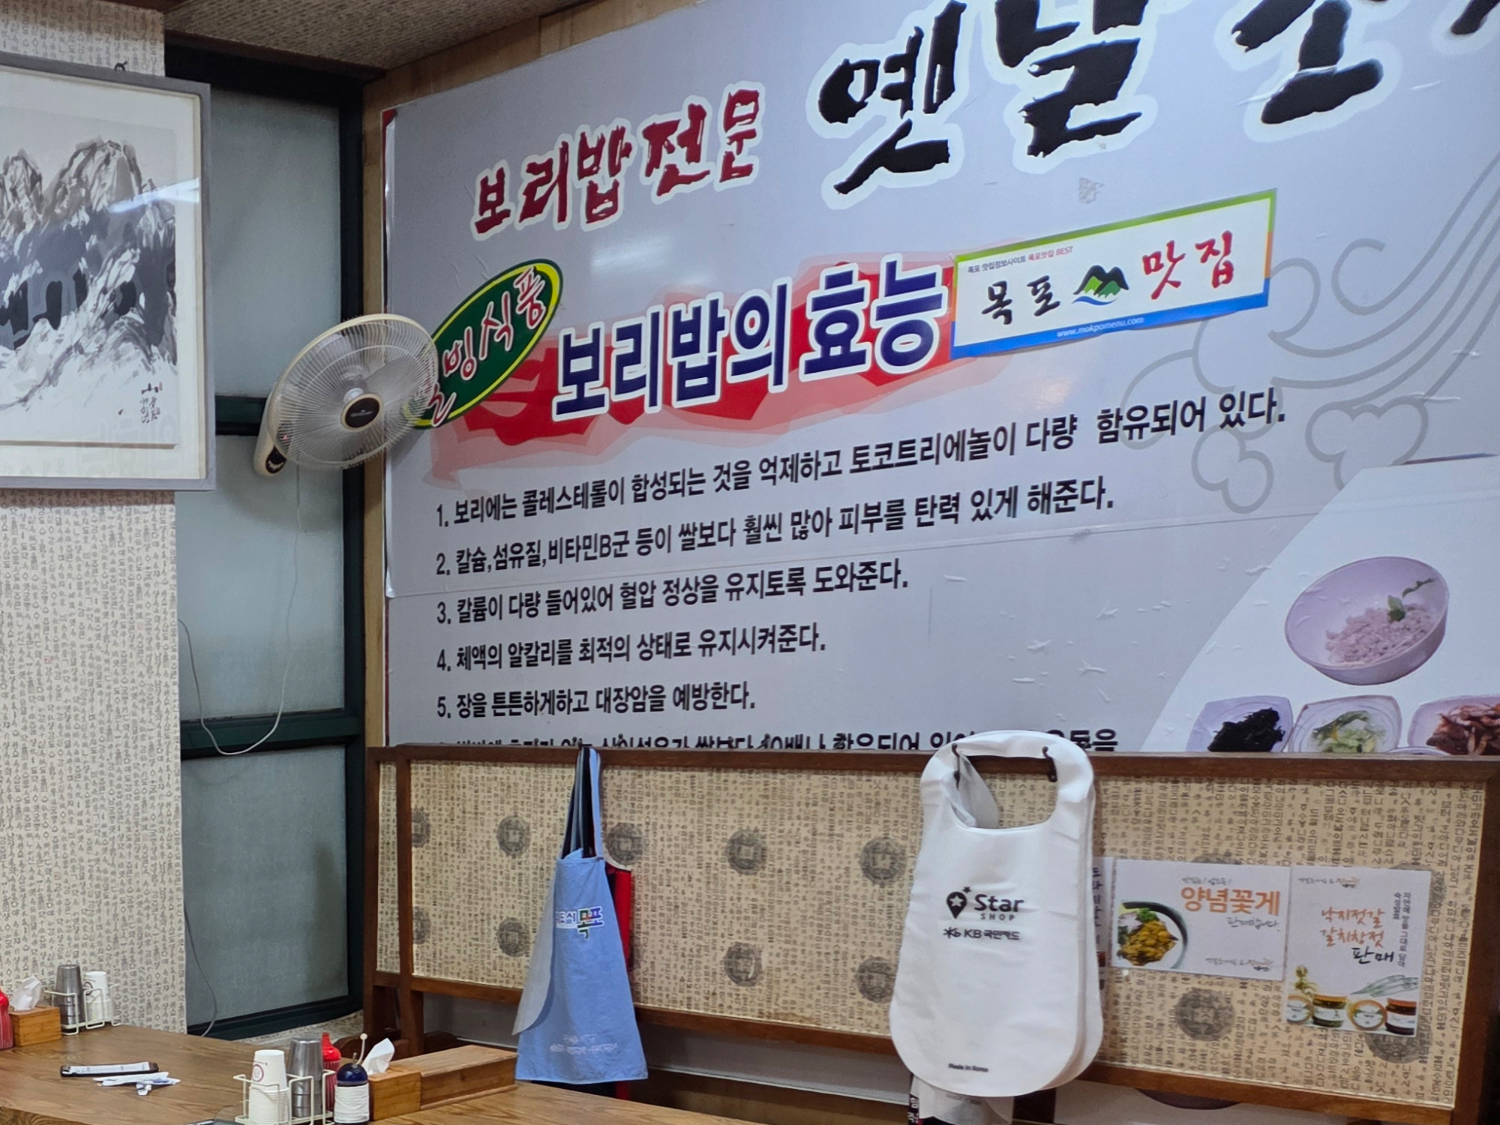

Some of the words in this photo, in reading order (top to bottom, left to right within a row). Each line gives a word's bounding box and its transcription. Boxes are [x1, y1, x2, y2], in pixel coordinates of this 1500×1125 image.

[475, 85, 762, 234] 보리밥전문
[981, 275, 1061, 325] 목포
[1142, 230, 1236, 299] 맛집
[426, 263, 546, 427] 빙식품
[556, 282, 790, 418] 보리밥의
[803, 262, 949, 377] 효능
[437, 503, 449, 527] 1.
[454, 493, 517, 525] 보리에는
[523, 477, 625, 517] 콜레스테롤이
[632, 468, 706, 503] 합성되는
[713, 459, 751, 493] 것을
[759, 449, 842, 486] 억제하고
[849, 422, 1016, 474] 토코트리에놀이
[1026, 414, 1077, 451] 다량
[1097, 396, 1207, 444] 함유되어
[1219, 387, 1286, 430] 있다.
[436, 553, 450, 576] 2.
[636, 525, 672, 557] 등이
[678, 517, 736, 552] 쌀보다
[743, 512, 782, 545] 훨씬
[790, 507, 832, 541] 많아
[839, 499, 906, 534] 피부를
[915, 492, 960, 528] 탄력
[970, 485, 1018, 522] 있게
[1027, 475, 1114, 514] 해준다.
[437, 602, 451, 625] 3.
[457, 594, 502, 624] 칼륨이
[509, 591, 540, 619] 다량
[545, 584, 613, 616] 들어있어
[620, 579, 656, 610] 혈압
[663, 574, 719, 607] 정상을
[725, 566, 806, 601] 유지토록
[812, 557, 908, 593] 도와준다.
[437, 649, 451, 672] 4.
[456, 643, 503, 671] 체액의
[508, 638, 573, 669] 알칼리를
[579, 634, 631, 664] 최적의
[636, 631, 692, 662] 상태로
[698, 621, 826, 658] 유지시켜준다.
[437, 695, 451, 719] 5.
[457, 692, 487, 719] 장을
[492, 687, 589, 718] 튼튼하게하고
[596, 684, 666, 715] 대장암을
[672, 680, 756, 712] 예방한다.
[974, 894, 1024, 912] Star
[1181, 887, 1280, 916] 양념꽃게
[1321, 907, 1385, 929] 낙지젓갈
[1352, 946, 1395, 965] 판매
